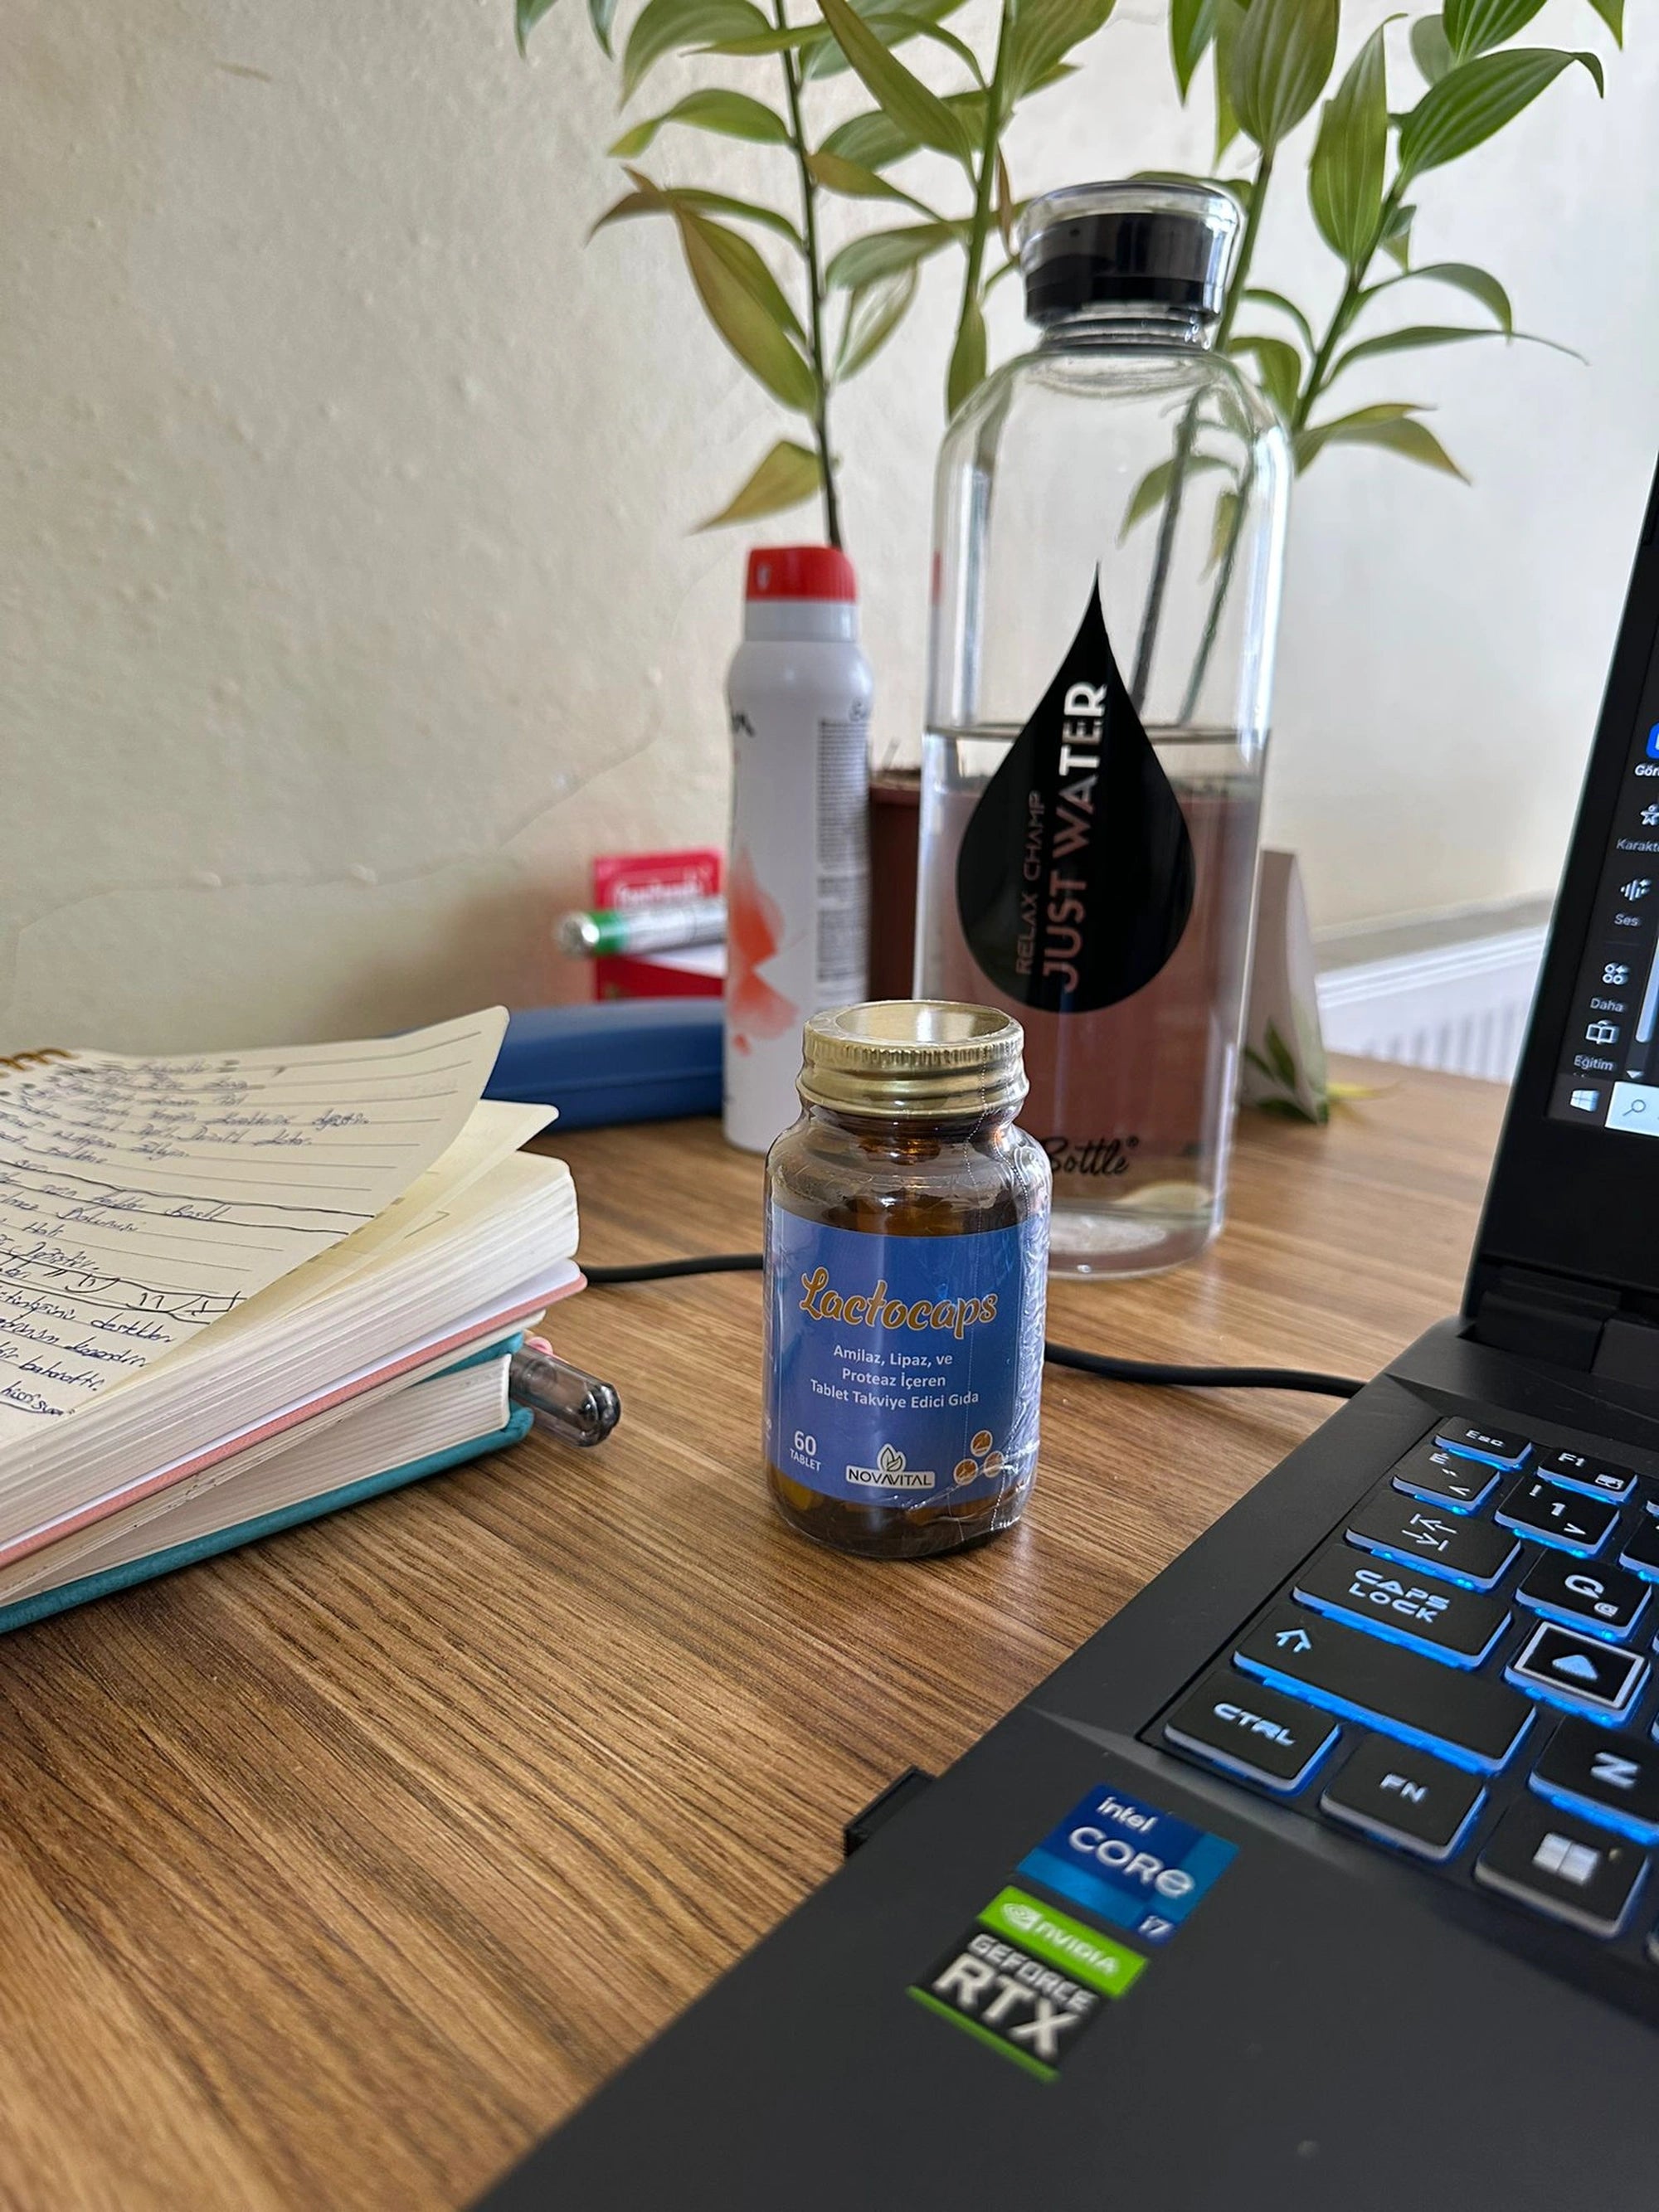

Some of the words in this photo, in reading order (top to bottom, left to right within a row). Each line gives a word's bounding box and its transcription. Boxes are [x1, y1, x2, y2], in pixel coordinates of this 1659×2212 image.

[1052, 681, 1108, 858] WATER
[1634, 763, 1659, 776] Gör
[1024, 790, 1045, 882] CHAMP
[1014, 892, 1039, 975] RELAX
[1043, 870, 1087, 993] JUST
[1614, 913, 1640, 926] Ses
[1590, 998, 1624, 1012] Daha
[1574, 1054, 1614, 1071] Eğitim
[800, 1266, 1000, 1339] Lactocaps
[833, 1344, 886, 1366] Amilaz,
[889, 1353, 932, 1369] Lipaz,
[936, 1354, 953, 1365] ve
[842, 1367, 897, 1387] Proteaz
[900, 1372, 946, 1390] İçeren
[810, 1378, 849, 1402] Tablet
[852, 1390, 907, 1411] Takviye
[911, 1396, 945, 1409] Edici
[948, 1391, 980, 1407] Gıda
[794, 1430, 818, 1456] 60
[1466, 1429, 1505, 1447] Esc
[789, 1448, 822, 1472] TABLET
[1558, 1452, 1587, 1467] F1
[848, 1468, 932, 1486] NOVAVITAL
[1550, 1502, 1567, 1517] 1
[1355, 1568, 1450, 1611] CAPS
[1564, 1575, 1605, 1599] Q
[1348, 1582, 1438, 1624] LOCK
[1214, 1702, 1297, 1746] CTRL
[1379, 1772, 1428, 1804] FN
[1095, 1796, 1158, 1834] intel
[967, 1932, 1100, 2012] GEFORCE
[932, 1952, 1079, 2060] RTX
